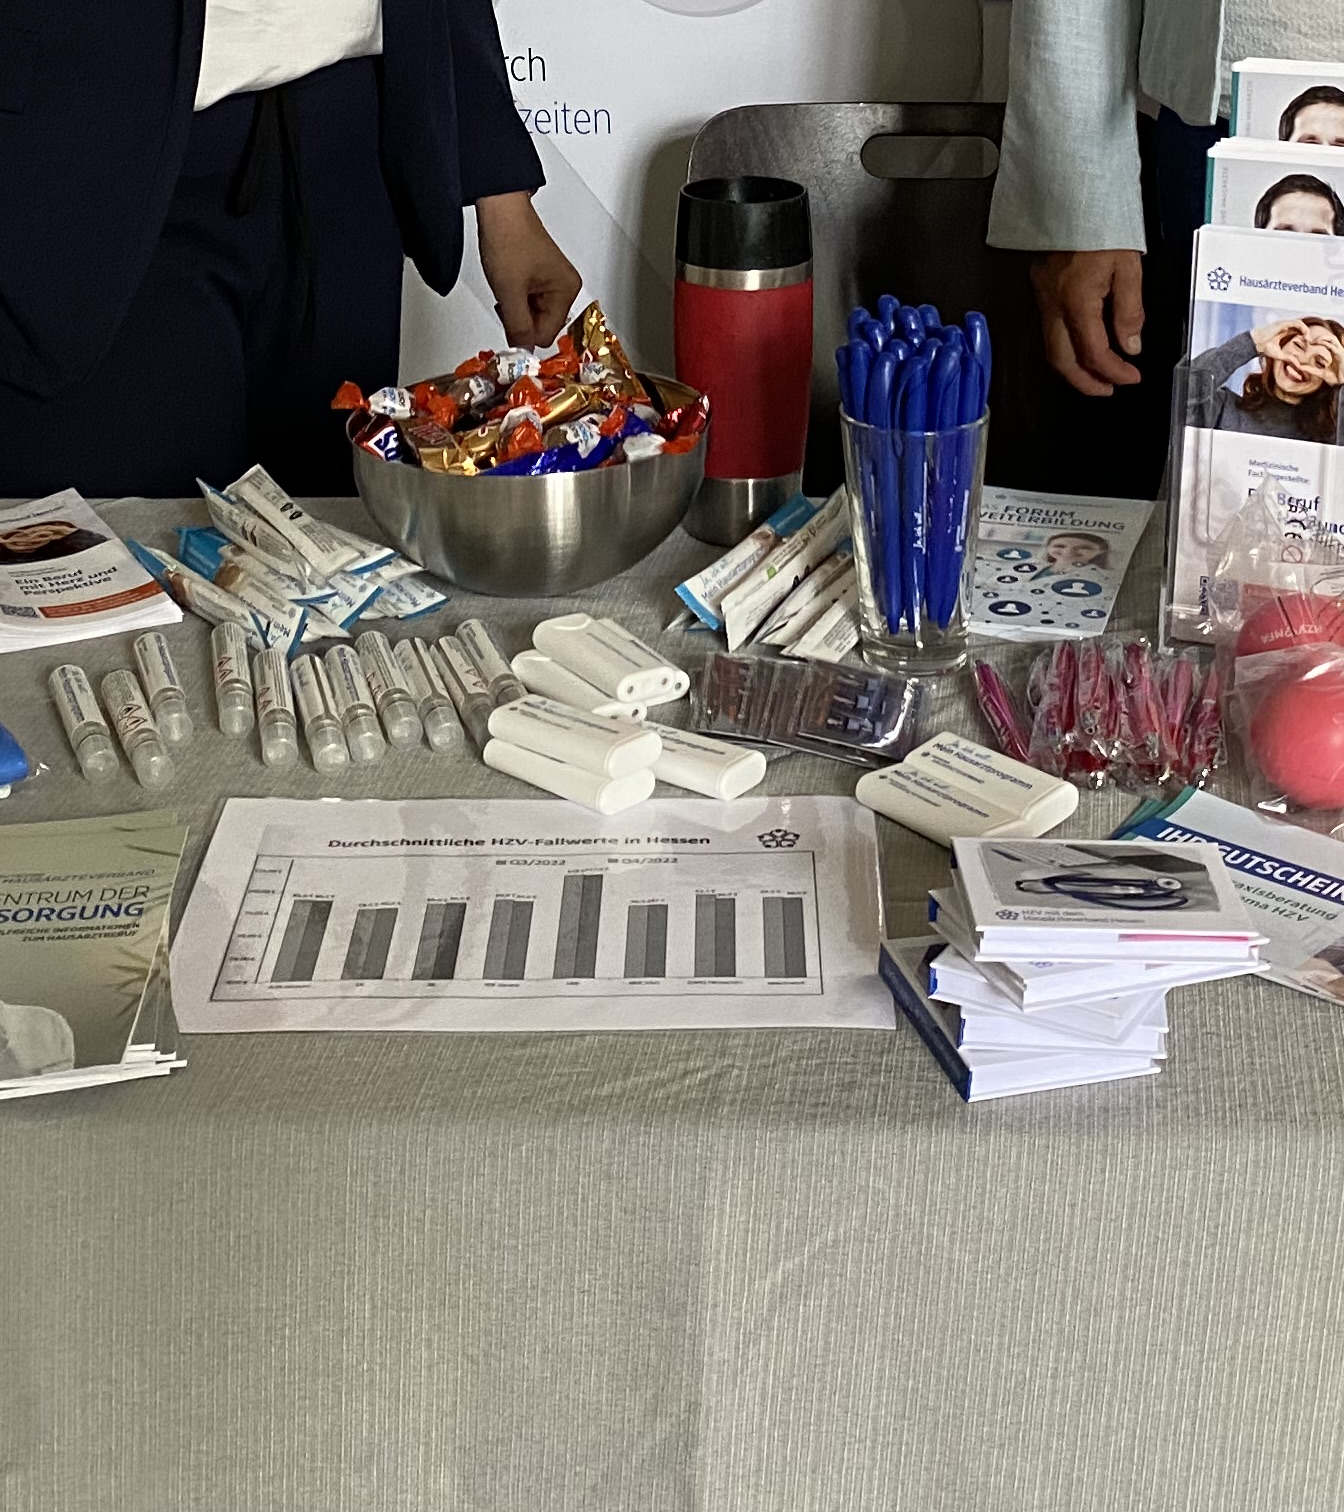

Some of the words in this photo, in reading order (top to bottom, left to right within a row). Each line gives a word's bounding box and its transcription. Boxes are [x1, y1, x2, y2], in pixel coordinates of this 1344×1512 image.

[519, 100, 613, 136] zeiten
[1239, 275, 1328, 296] Hausärzteverband
[1004, 505, 1076, 519] FORUM
[88, 566, 118, 579] und
[22, 576, 112, 596] Perspektive
[327, 838, 486, 848] Durchschnittliche
[624, 836, 641, 845] in
[646, 835, 712, 845] Hessen
[99, 885, 150, 902] DER
[1271, 905, 1310, 922] HZV
